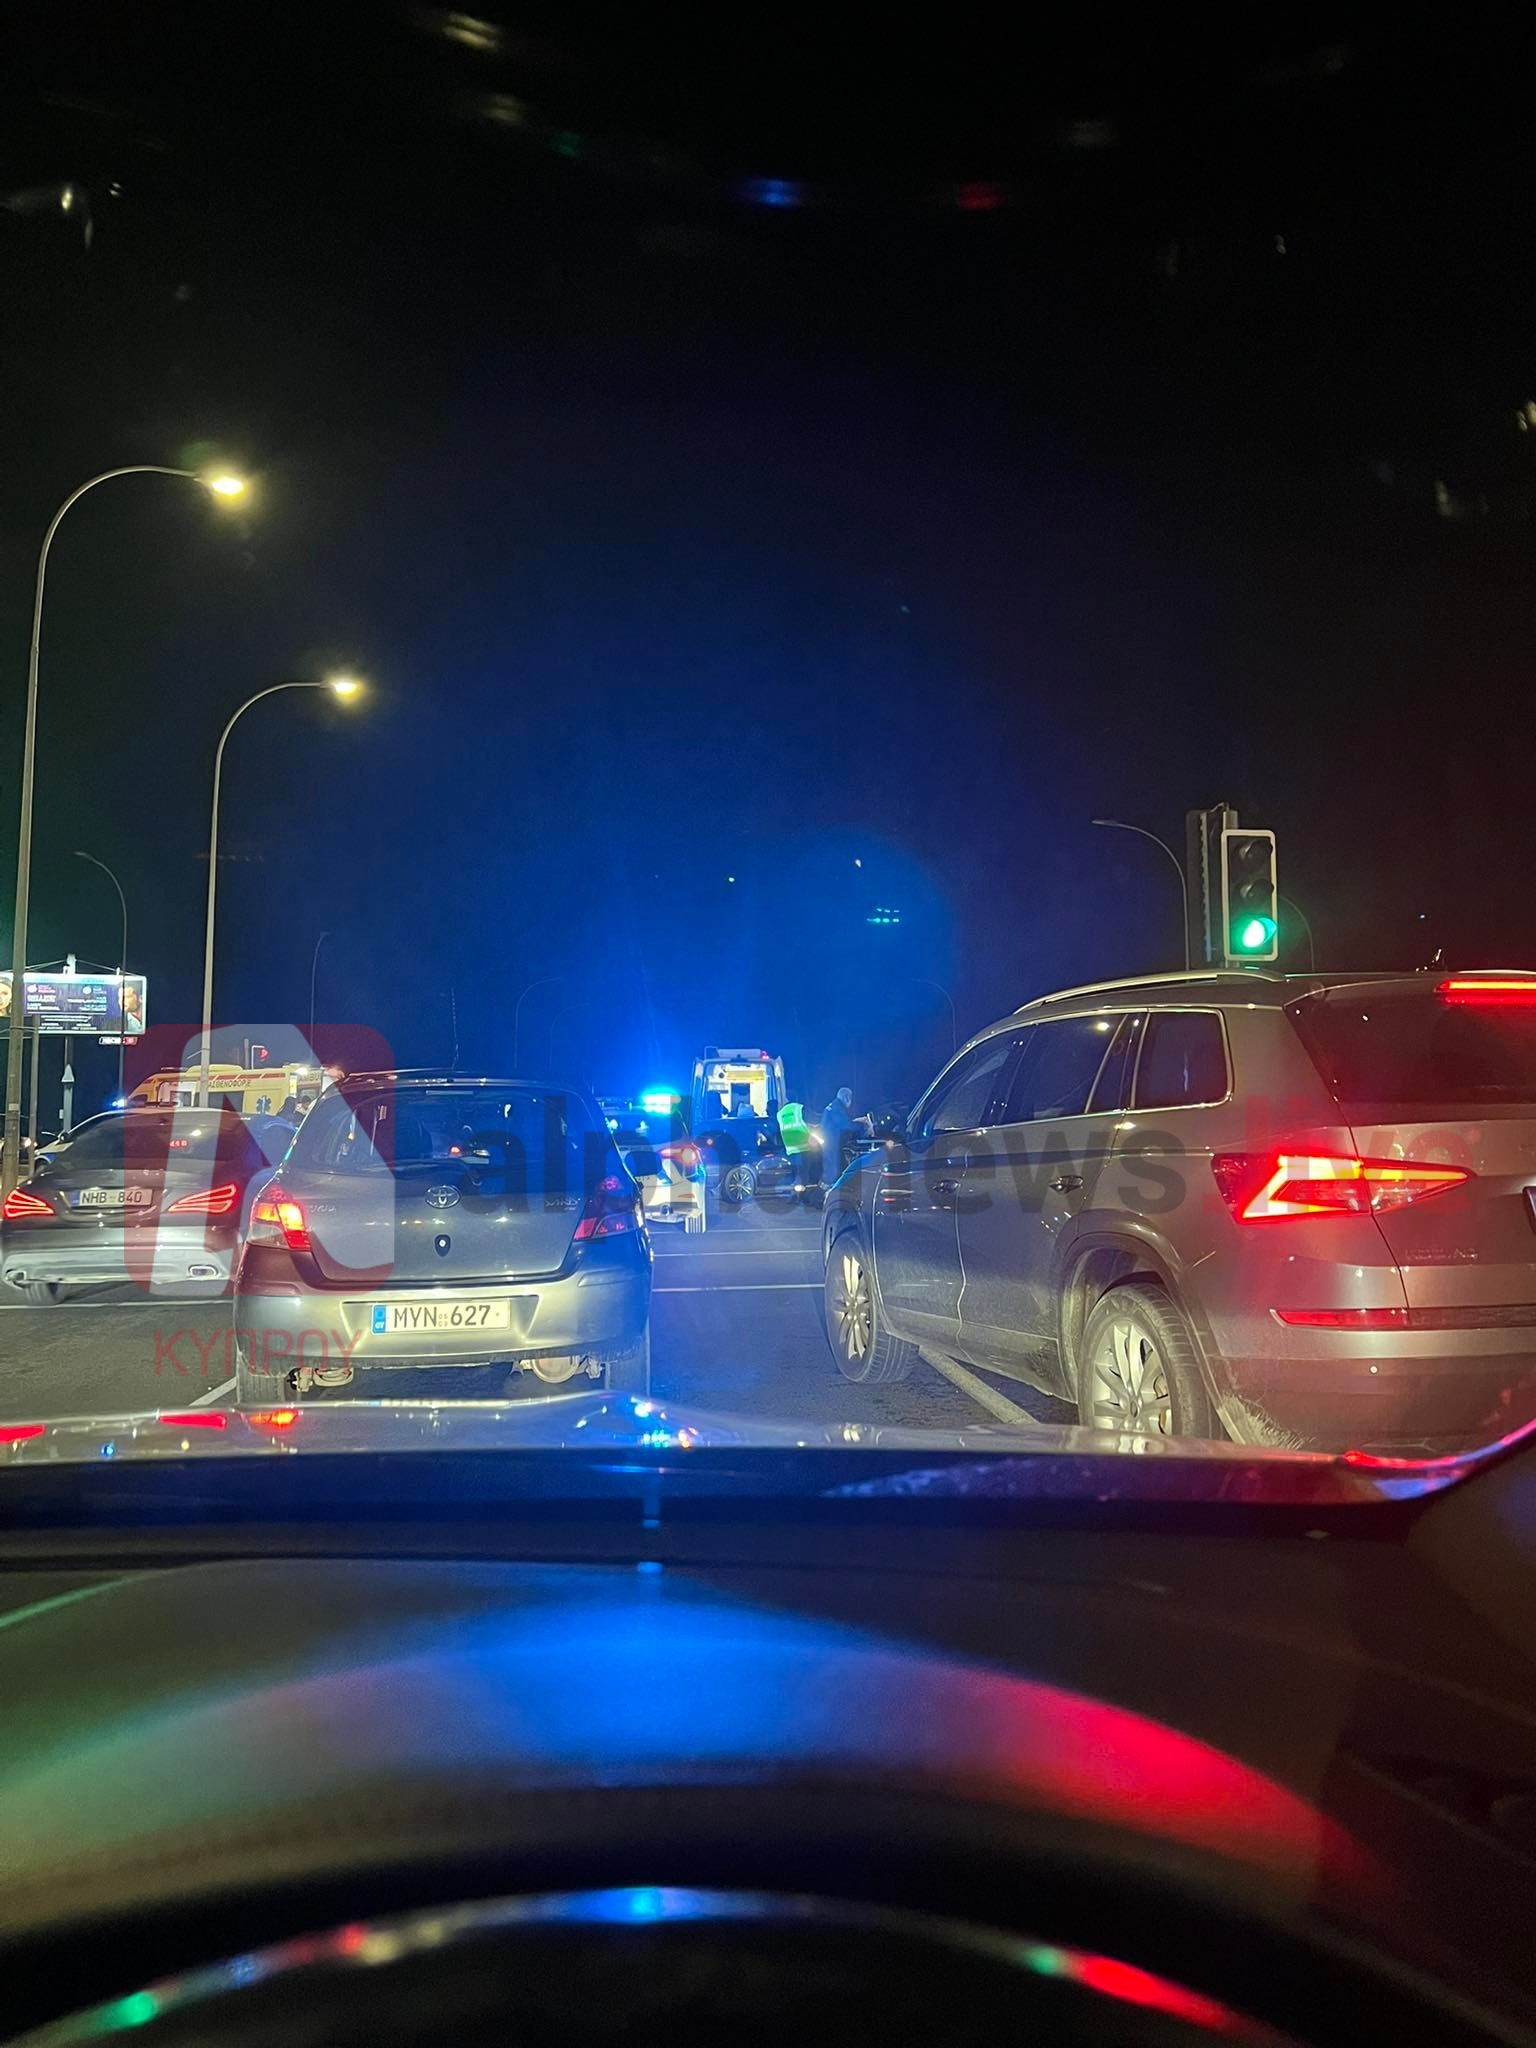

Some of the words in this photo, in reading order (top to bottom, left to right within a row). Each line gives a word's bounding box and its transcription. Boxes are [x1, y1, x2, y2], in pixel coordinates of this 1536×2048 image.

[82, 1191, 107, 1204] NHB
[118, 1191, 142, 1204] 840
[394, 1305, 437, 1329] MYN
[450, 1304, 491, 1326] 627
